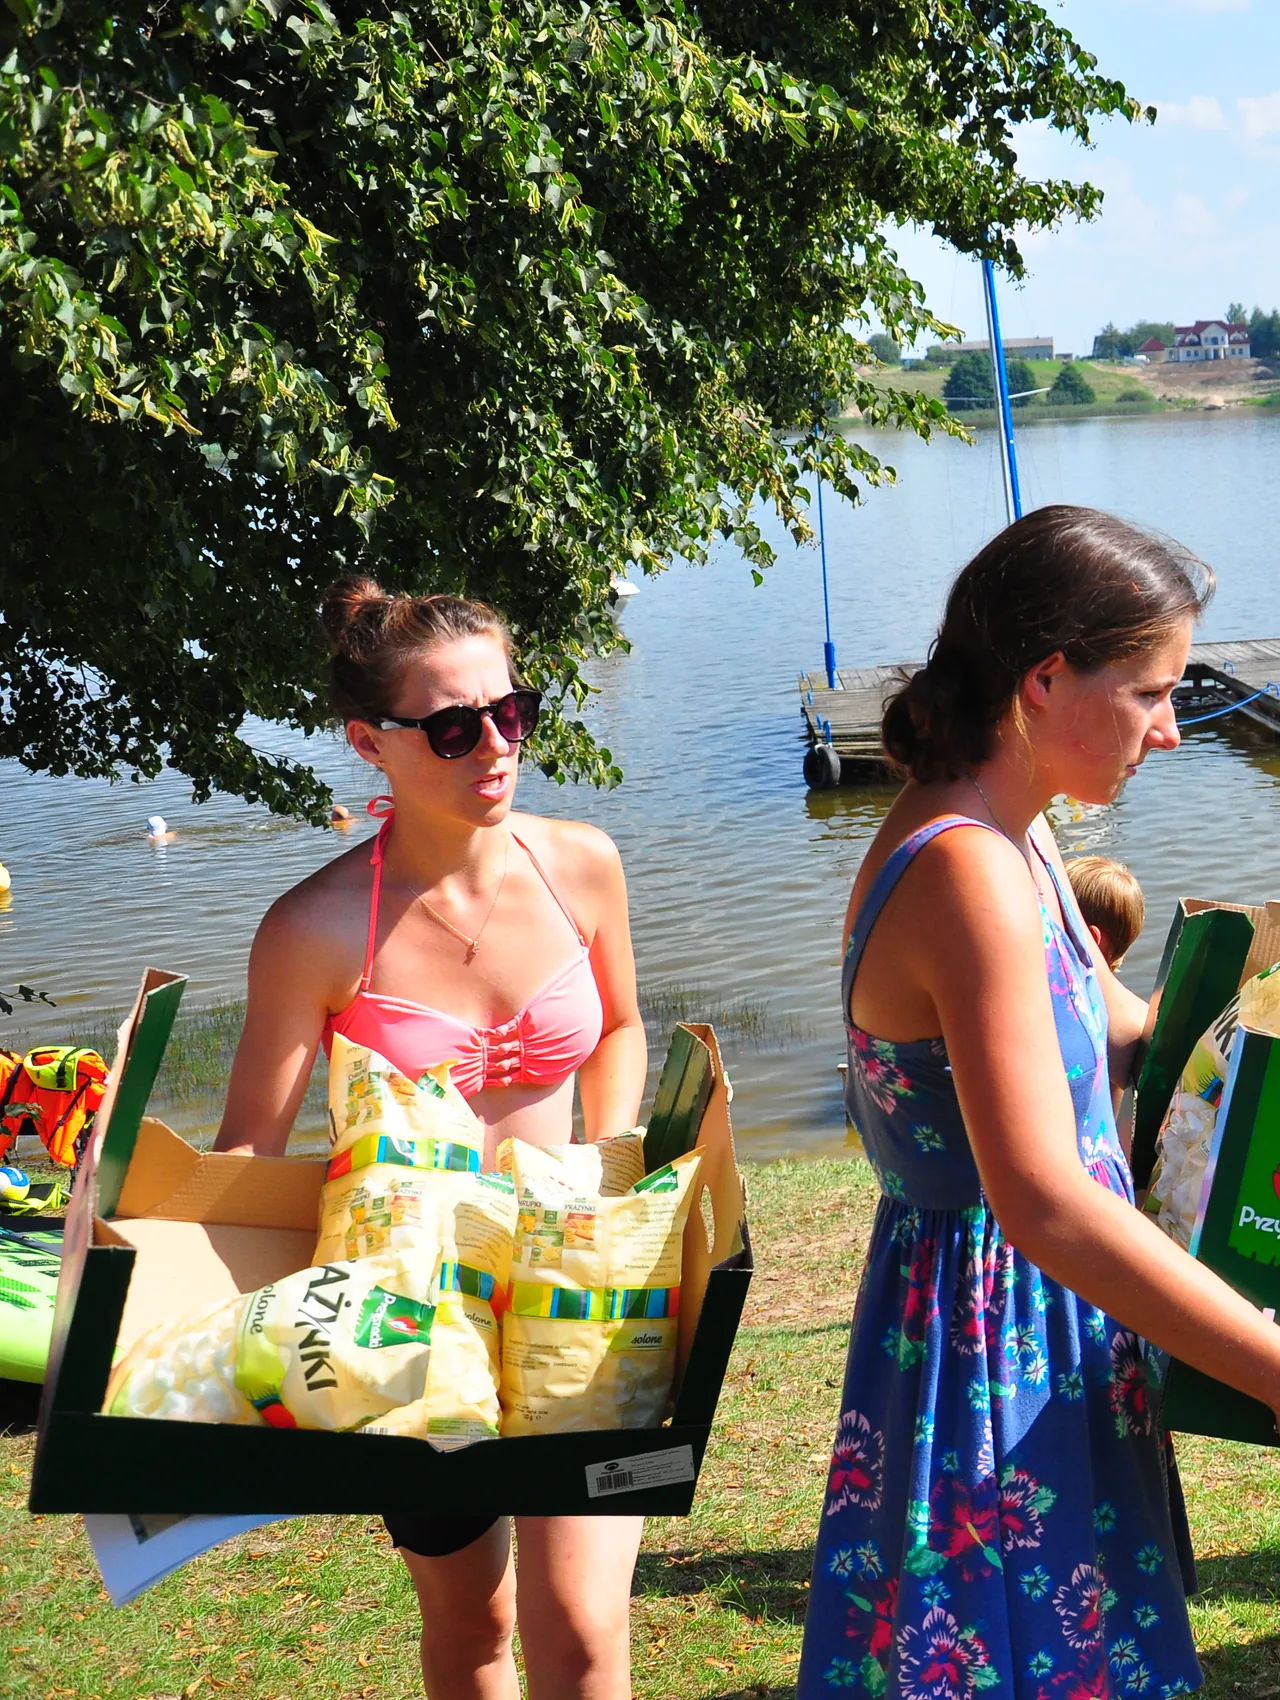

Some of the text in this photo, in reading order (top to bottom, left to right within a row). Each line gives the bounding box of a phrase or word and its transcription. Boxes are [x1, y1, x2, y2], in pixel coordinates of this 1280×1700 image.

[250, 1284, 276, 1335] olone
[465, 1311, 493, 1327] olone
[295, 1261, 356, 1392] AŻYNKI
[631, 1332, 664, 1345] solone
